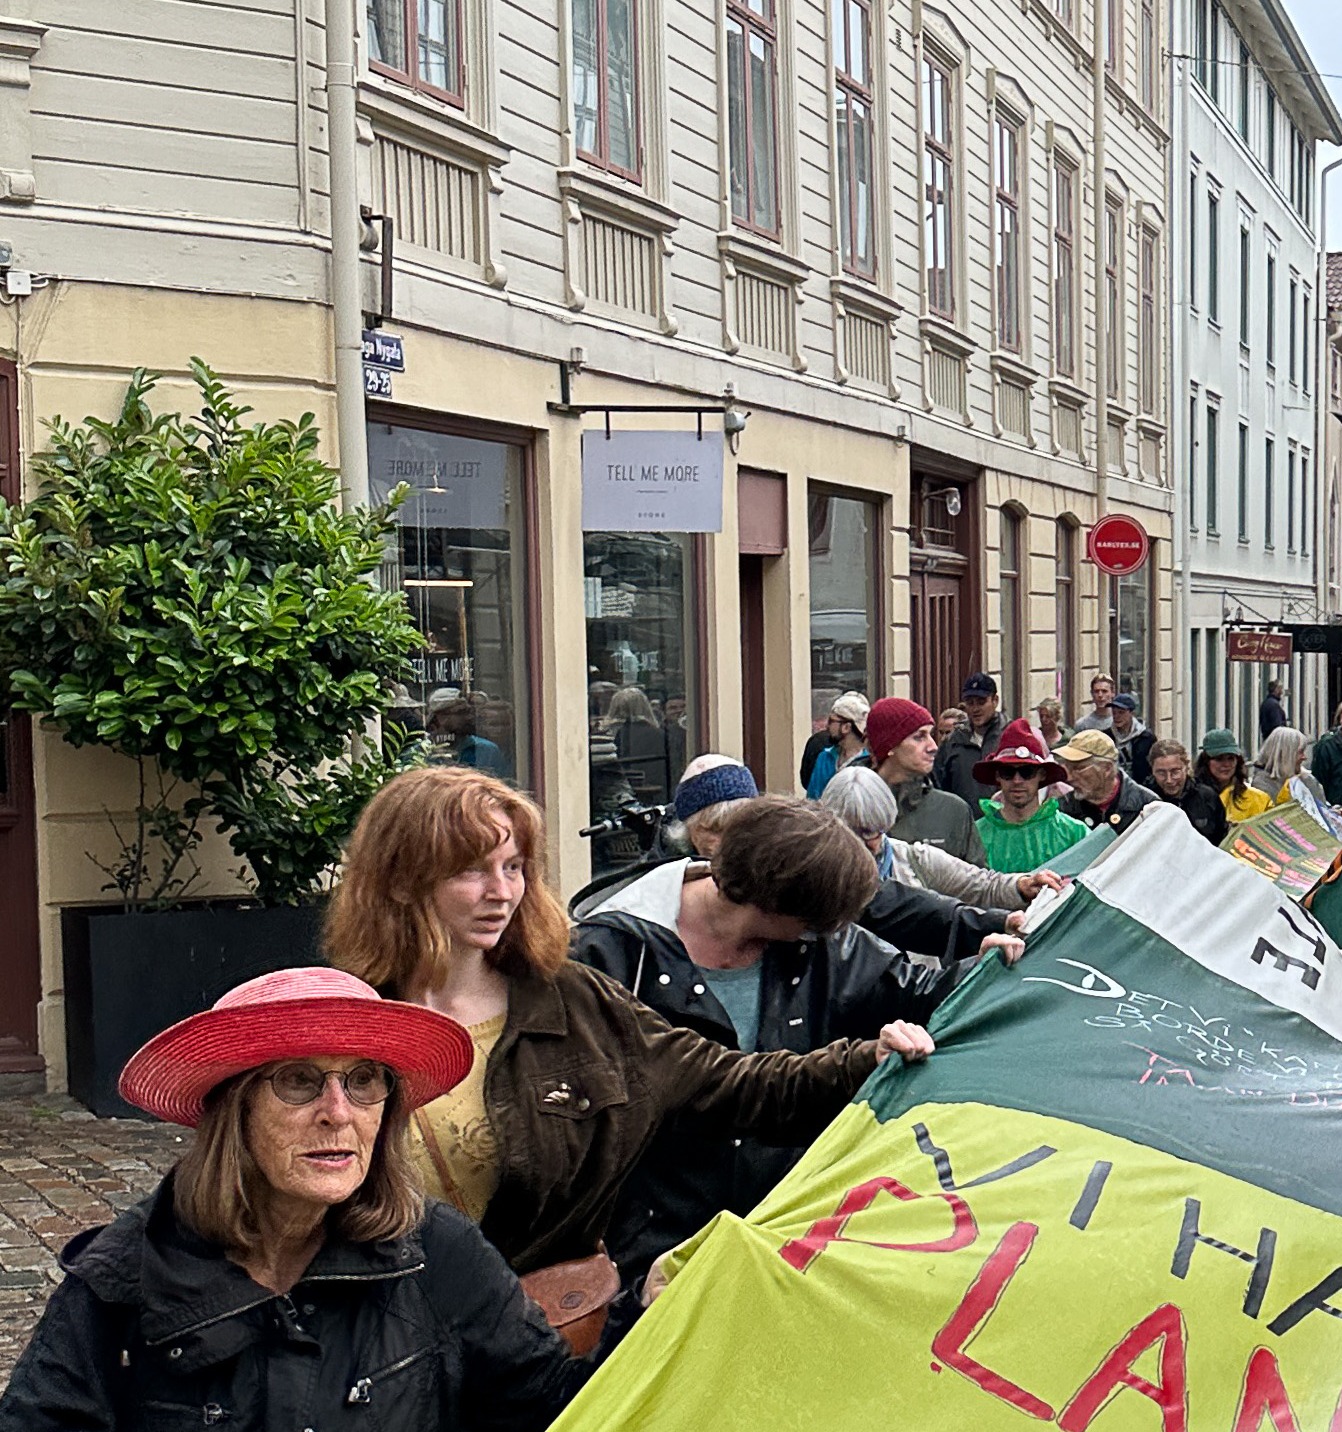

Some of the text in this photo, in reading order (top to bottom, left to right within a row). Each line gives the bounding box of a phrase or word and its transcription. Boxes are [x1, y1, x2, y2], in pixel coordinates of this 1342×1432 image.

[607, 464, 700, 482] TELL ME MORE
[912, 1121, 1112, 1232] VI
